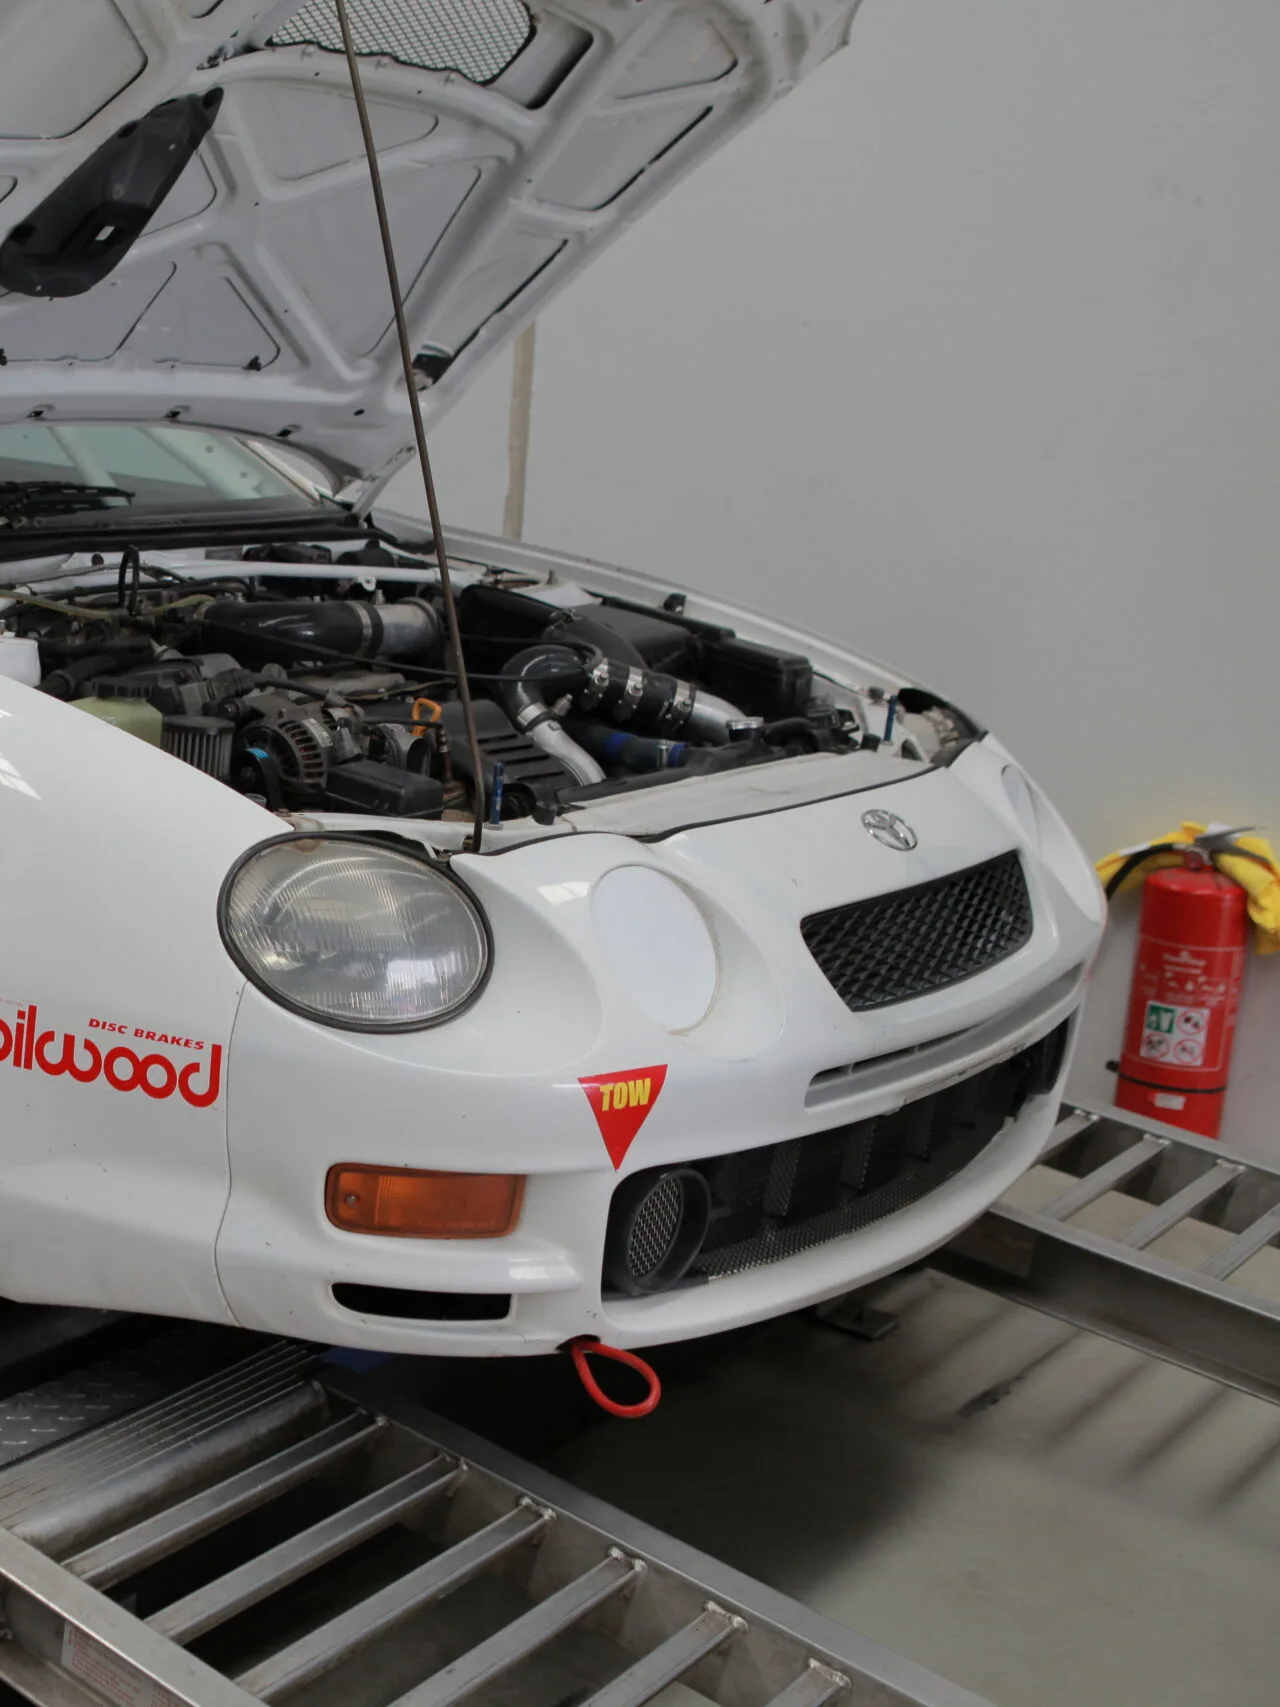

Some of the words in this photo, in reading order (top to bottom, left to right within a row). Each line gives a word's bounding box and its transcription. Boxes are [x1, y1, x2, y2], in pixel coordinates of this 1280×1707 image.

[88, 1018, 128, 1034] DISC
[134, 1028, 205, 1050] BRAKES
[599, 1078, 651, 1112] TOW
